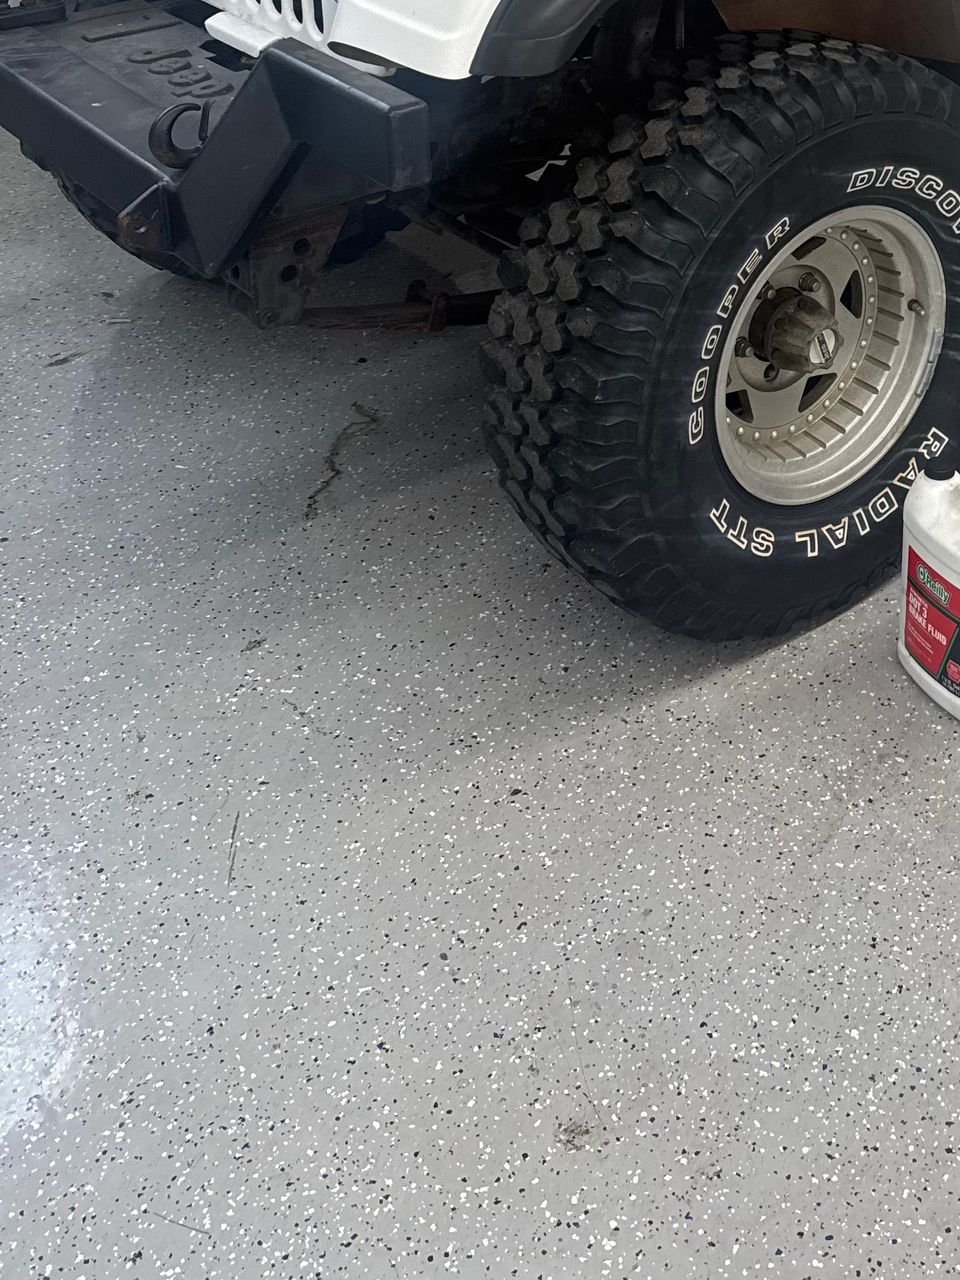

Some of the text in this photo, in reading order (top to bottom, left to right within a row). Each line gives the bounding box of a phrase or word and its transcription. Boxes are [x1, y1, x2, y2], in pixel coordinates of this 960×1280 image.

[127, 49, 235, 98] Jeep
[688, 216, 790, 445] COOPER
[709, 427, 950, 558] RADIAL STT
[909, 592, 928, 619] DOT 3
[917, 563, 950, 606] O'Reilly
[909, 602, 927, 629] BRAKE
[927, 623, 947, 646] FLUID
